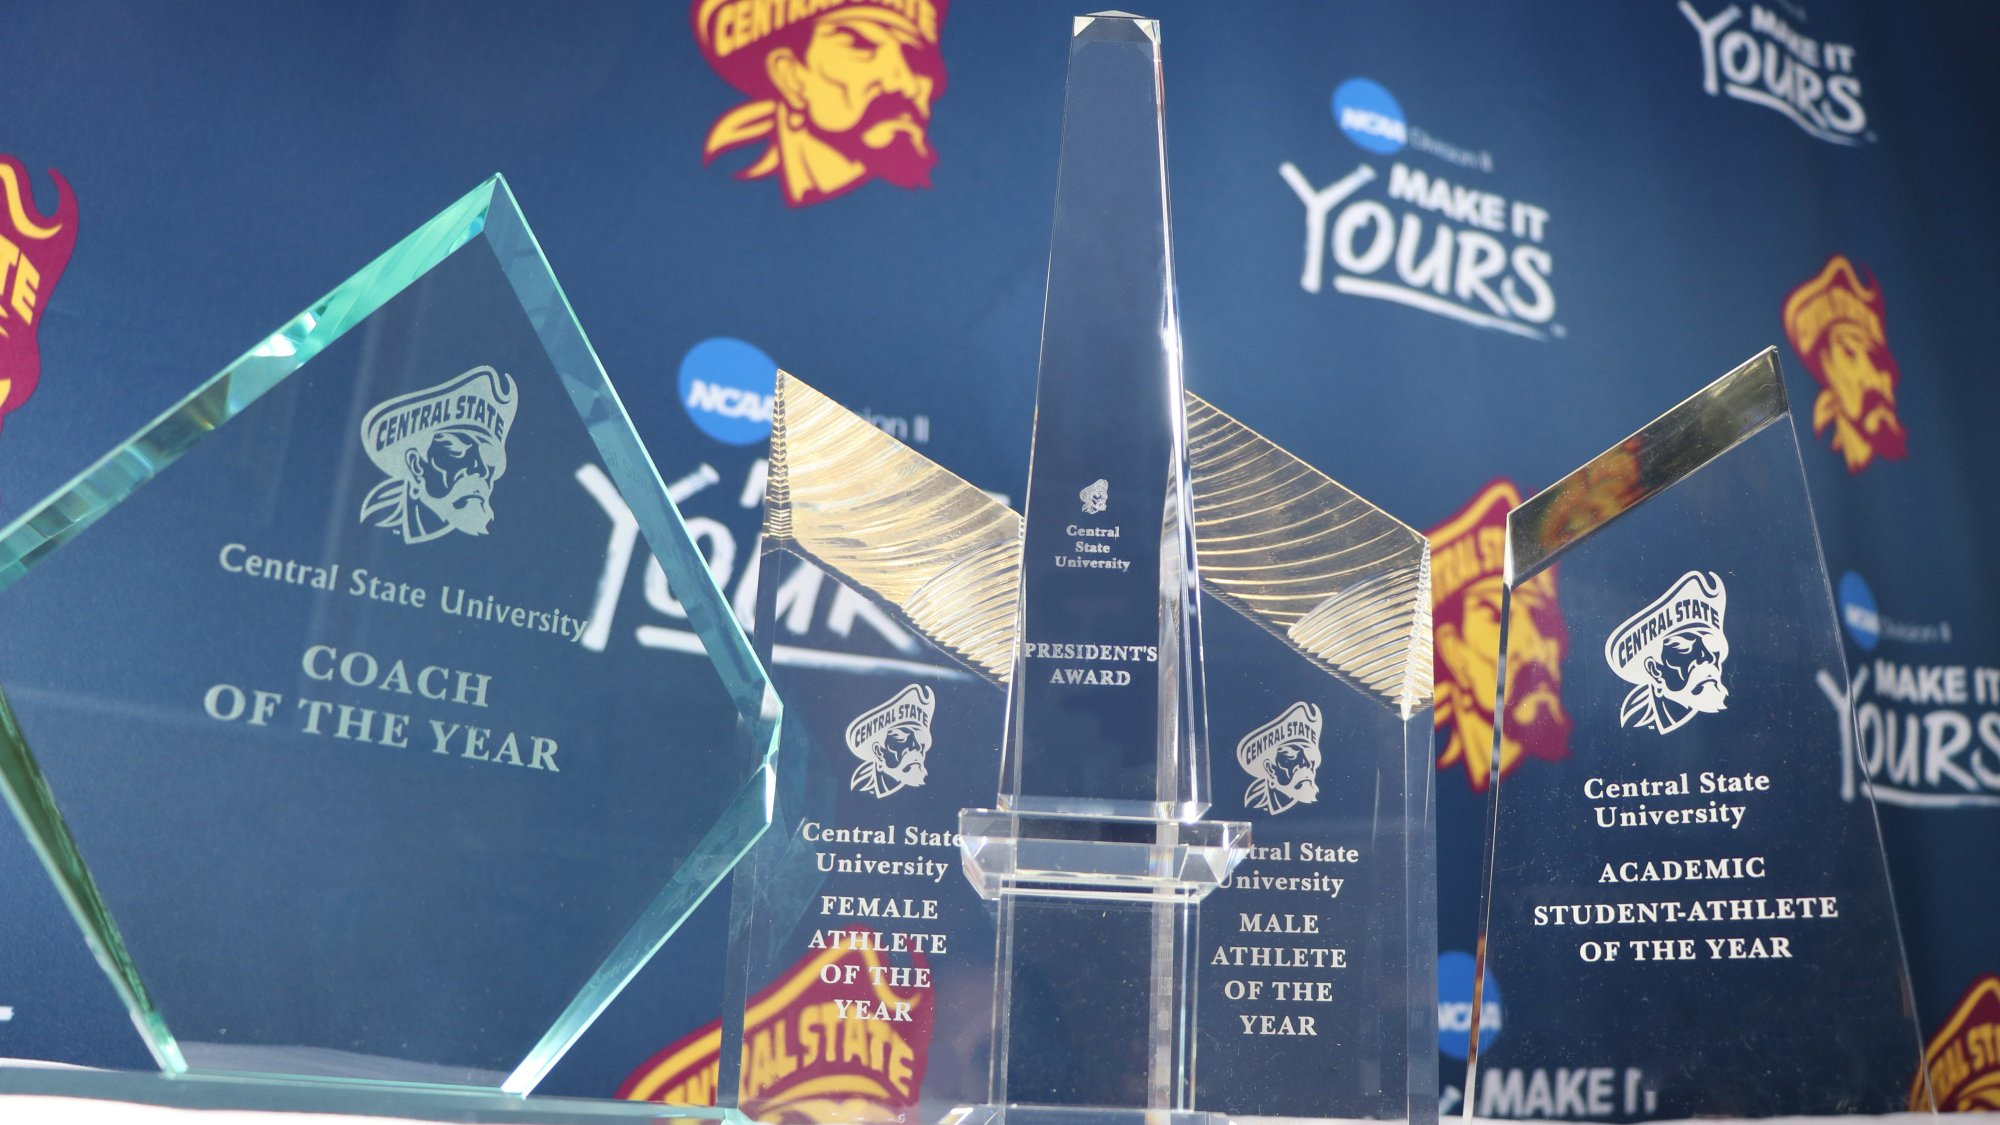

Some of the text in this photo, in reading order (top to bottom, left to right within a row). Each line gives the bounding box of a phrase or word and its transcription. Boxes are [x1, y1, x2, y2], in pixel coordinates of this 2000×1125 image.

[1678, 0, 1866, 134] YOURS
[1824, 42, 1855, 73] IT
[1388, 163, 1549, 242] MAKE IT
[1279, 162, 1556, 323] YOURS
[376, 395, 505, 452] CENTRAL STATE
[1066, 524, 1120, 538] Central
[1075, 541, 1111, 554] State
[1055, 556, 1131, 572] University
[219, 543, 589, 643] Central State University
[1618, 599, 1721, 669] CENTRAL STATE
[1025, 643, 1158, 662] PRESIDENT'S
[302, 644, 493, 708] COACH
[1050, 668, 1131, 686] AWARD
[1875, 658, 1968, 704] MAKE
[204, 684, 561, 772] OF THE YEAR
[855, 703, 928, 748] CENTRAL STATE
[1246, 721, 1316, 766] CENTRAL STATE
[1583, 771, 1770, 800] Central State
[1594, 800, 1746, 829] University
[802, 822, 961, 847] Central State
[1300, 842, 1359, 862] State
[816, 853, 948, 883] University
[1598, 857, 1765, 883] ACADEMIC
[820, 896, 938, 919] FEMALE
[1534, 896, 1839, 926] STUDENT-ATHLETE
[1239, 913, 1319, 934] MALE
[808, 929, 947, 954] ATHLETE
[1579, 937, 1793, 962] OF THE YEAR
[1211, 946, 1347, 968] ATHLETE
[820, 964, 930, 988] OF THE
[1224, 980, 1333, 1002] OF THE
[834, 999, 912, 1022] YEAR
[1239, 1015, 1317, 1035] YEAR
[799, 1003, 914, 1098] STATE
[1479, 1067, 1616, 1117] MAKE
